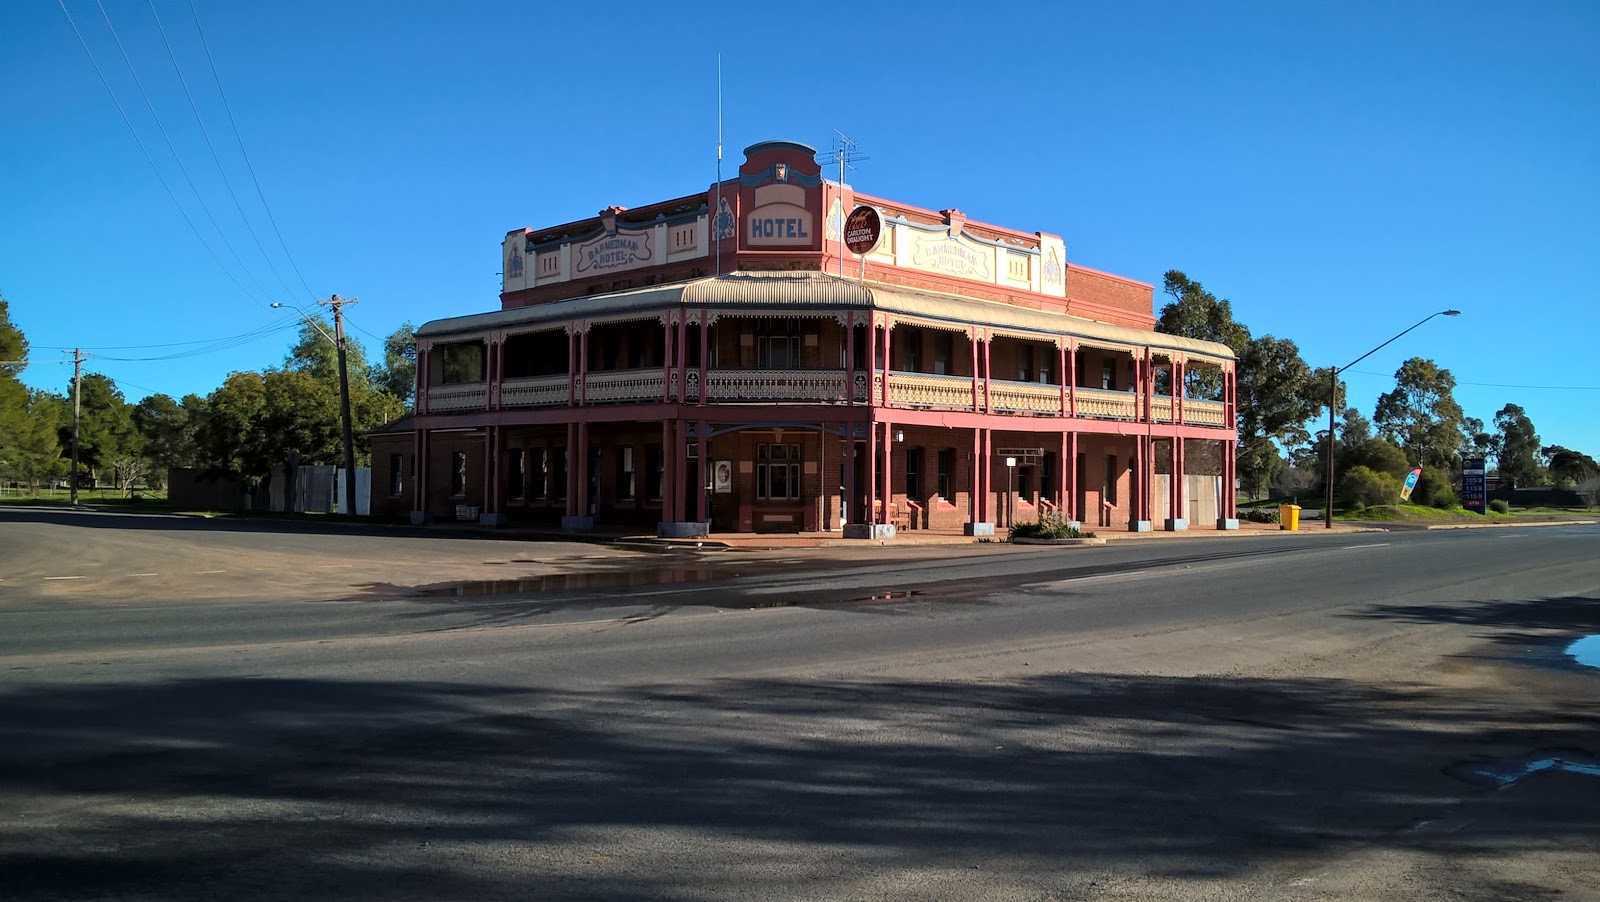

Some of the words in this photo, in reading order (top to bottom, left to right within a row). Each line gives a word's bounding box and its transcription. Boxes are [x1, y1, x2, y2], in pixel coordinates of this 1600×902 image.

[752, 218, 807, 238] HOTEL
[847, 228, 871, 238] CARLTON
[847, 234, 873, 244] DRAUGHT
[588, 239, 639, 261] BARMEDMAN
[600, 251, 625, 264] HOTEL
